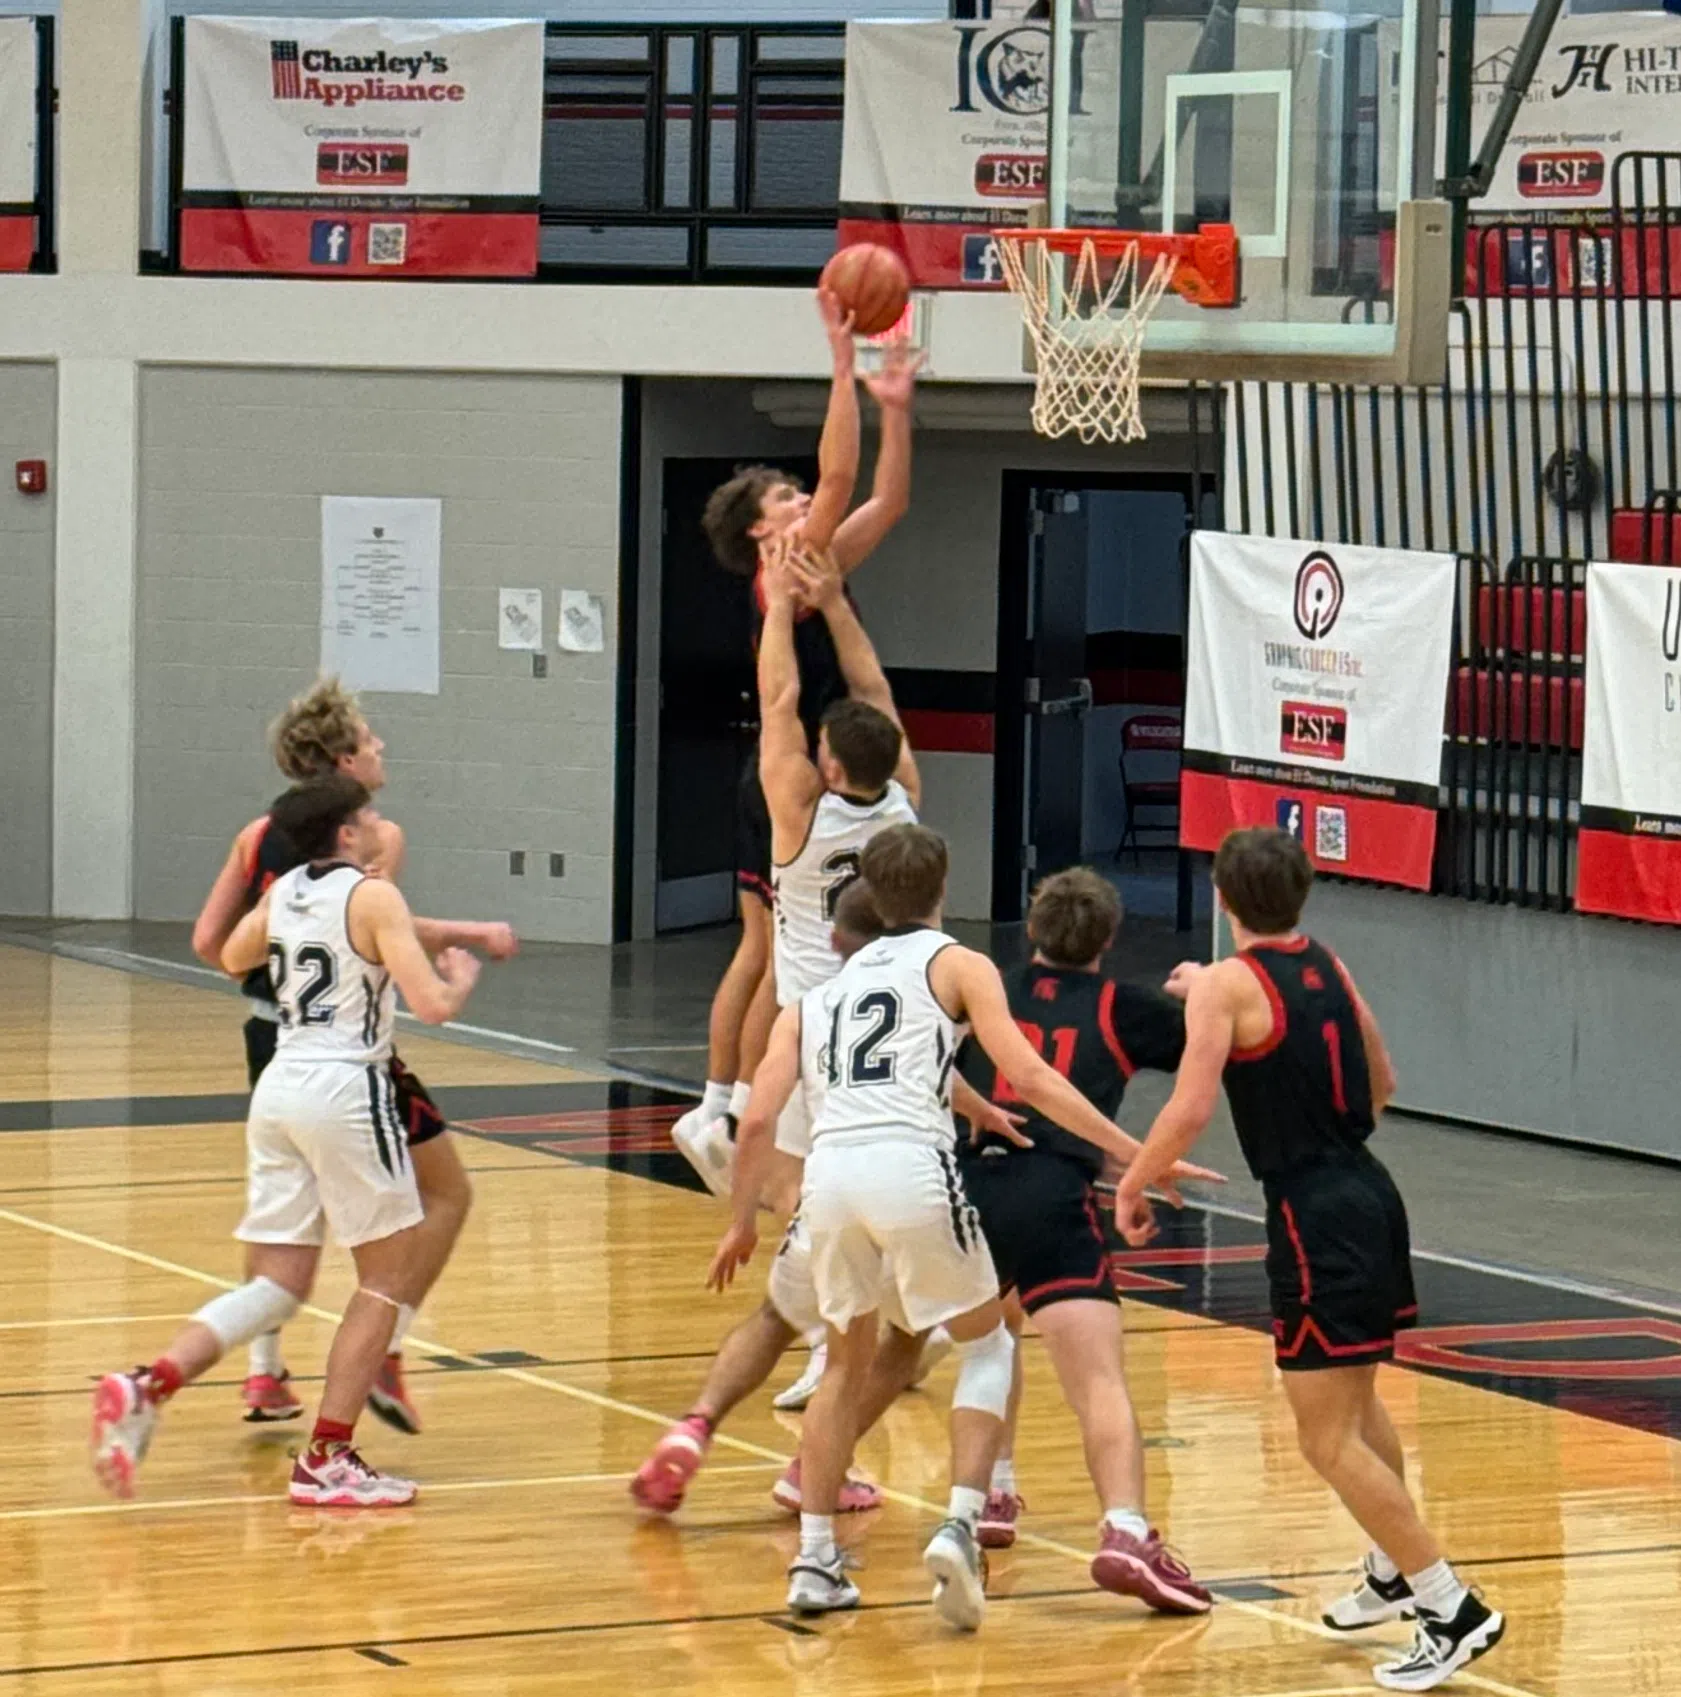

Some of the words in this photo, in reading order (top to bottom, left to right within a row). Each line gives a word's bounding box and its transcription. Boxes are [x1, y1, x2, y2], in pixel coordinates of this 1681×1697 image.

[302, 50, 448, 80] Charley's
[303, 77, 465, 107] Appliance
[1626, 73, 1681, 94] INTE
[336, 150, 394, 176] ESF
[991, 160, 1045, 188] ESF
[1534, 159, 1590, 187] ESF
[1293, 711, 1336, 747] ESF
[817, 987, 903, 1089] 12
[1322, 1020, 1348, 1114] 1
